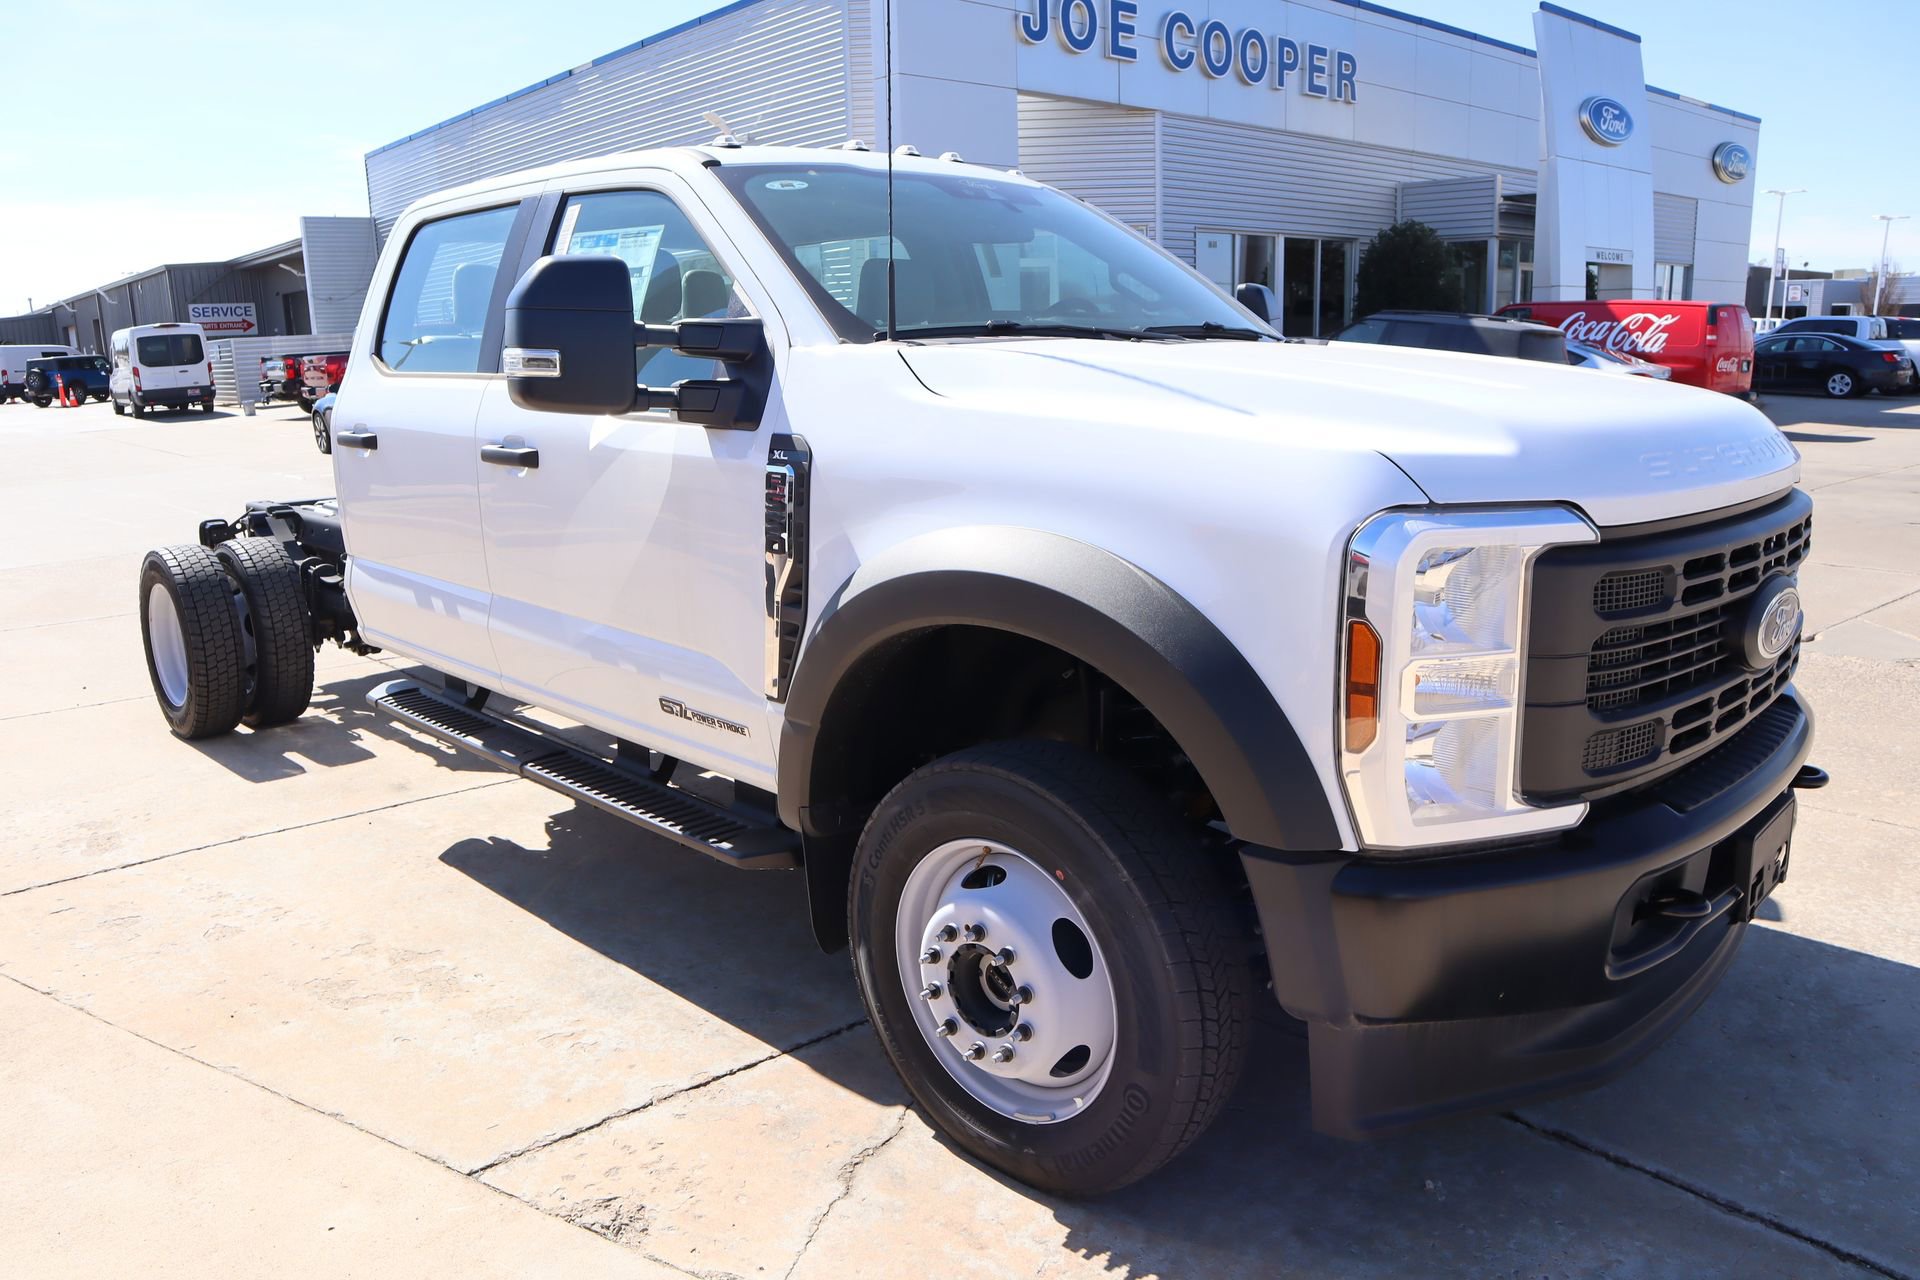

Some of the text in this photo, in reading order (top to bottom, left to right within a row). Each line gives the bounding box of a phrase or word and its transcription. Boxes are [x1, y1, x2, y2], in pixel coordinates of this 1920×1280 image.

[1017, 0, 1357, 102] JOE COOPER
[1600, 105, 1627, 135] Ford
[1728, 150, 1750, 175] Ford
[1595, 251, 1624, 262] WELCOME
[191, 305, 253, 318] SERVICE
[203, 321, 249, 330] ARTS ENTRANCE
[1557, 311, 1680, 353] Coca-Cola
[1716, 356, 1739, 373] Coca-Cola
[772, 449, 788, 460] XL
[658, 696, 693, 721] 6.7L
[691, 710, 717, 727] POWER
[716, 719, 747, 737] STROKE
